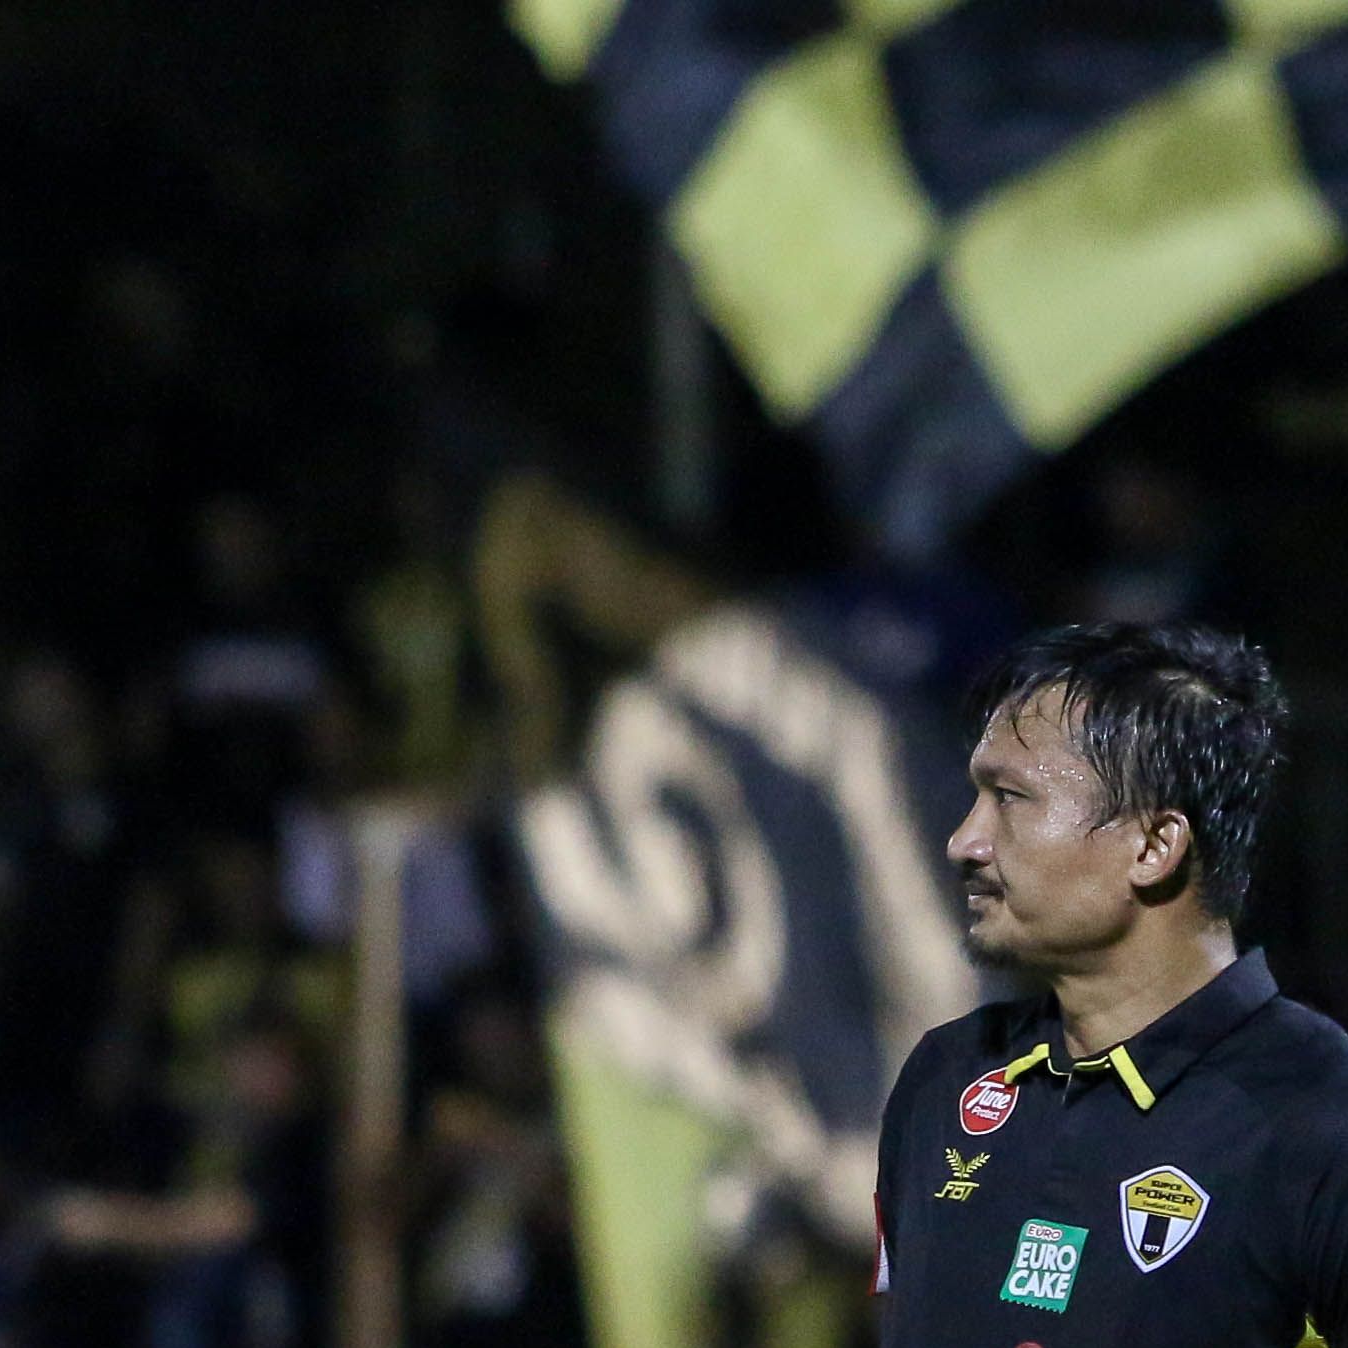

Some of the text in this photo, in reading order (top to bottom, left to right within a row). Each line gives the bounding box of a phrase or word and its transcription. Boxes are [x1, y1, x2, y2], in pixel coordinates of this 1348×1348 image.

[965, 1081, 1012, 1110] Tune
[1134, 1187, 1196, 1206] POWER
[1027, 1225, 1062, 1240] EURO
[1016, 1241, 1077, 1272] EURO
[1008, 1269, 1071, 1299] CAKE
